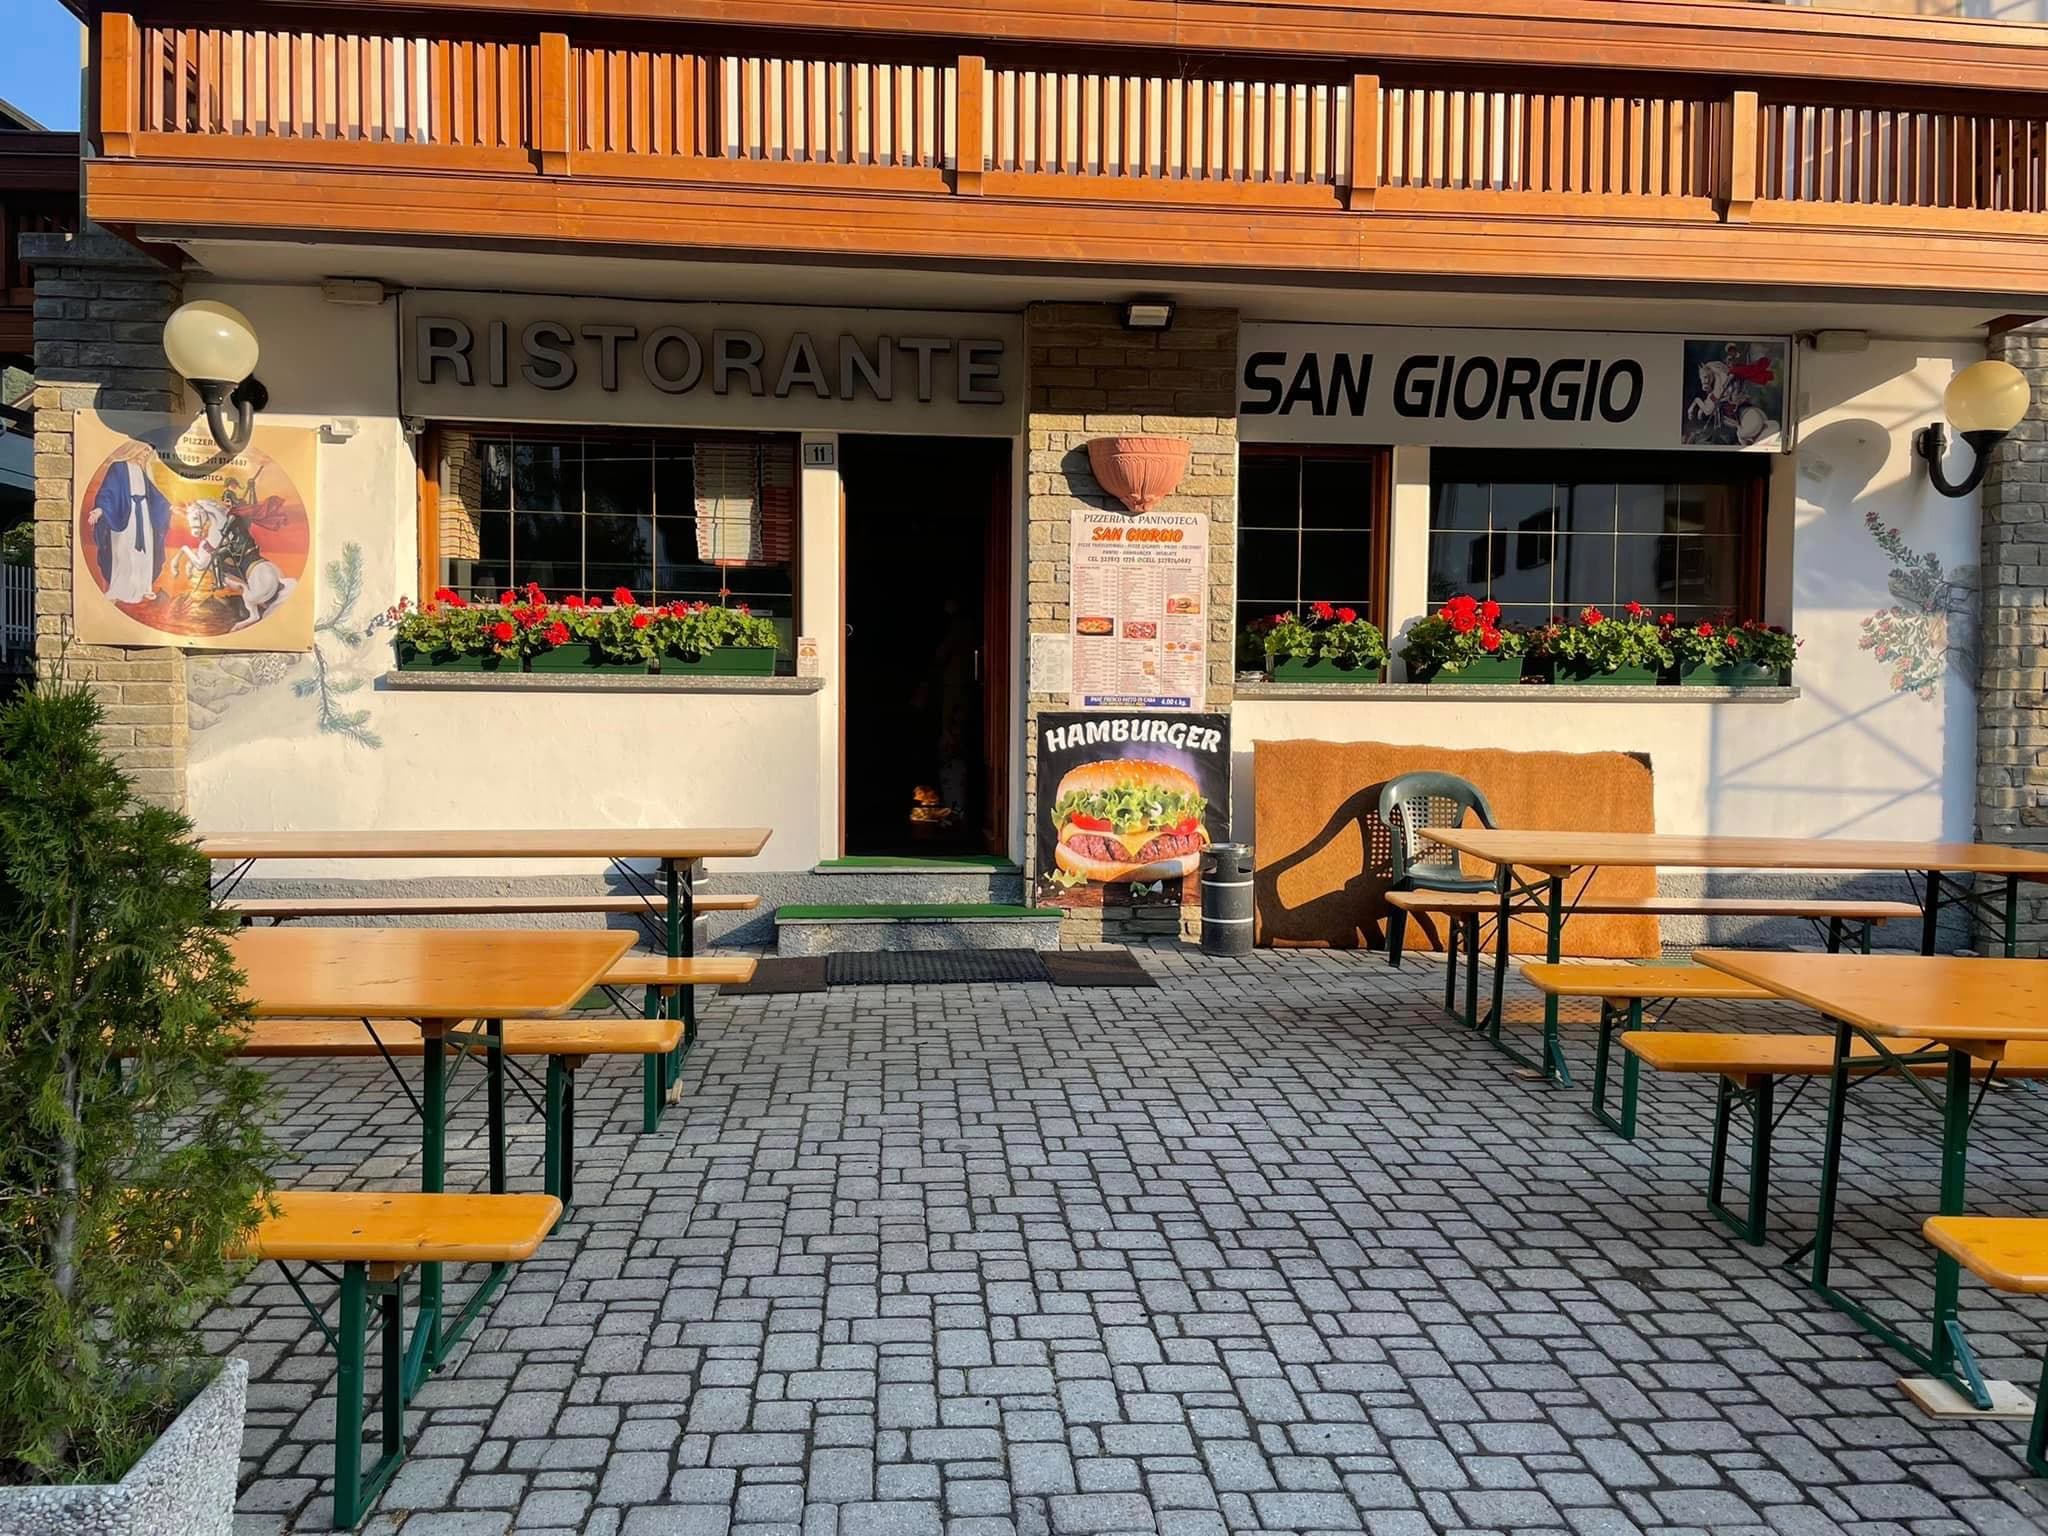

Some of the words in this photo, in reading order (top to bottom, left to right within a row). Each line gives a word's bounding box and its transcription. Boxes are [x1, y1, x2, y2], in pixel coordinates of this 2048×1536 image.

[416, 315, 1006, 404] RISTORANTE
[1240, 351, 1374, 416] SAN
[1393, 355, 1645, 423] GIORGIO
[813, 446, 826, 462] 11
[1083, 514, 1126, 524] PIZZERIA
[1138, 515, 1198, 525] PANINOTECA
[1092, 526, 1123, 541] SAN
[1126, 527, 1184, 543] GIORGIO
[1045, 719, 1222, 752] HAMBURGER
